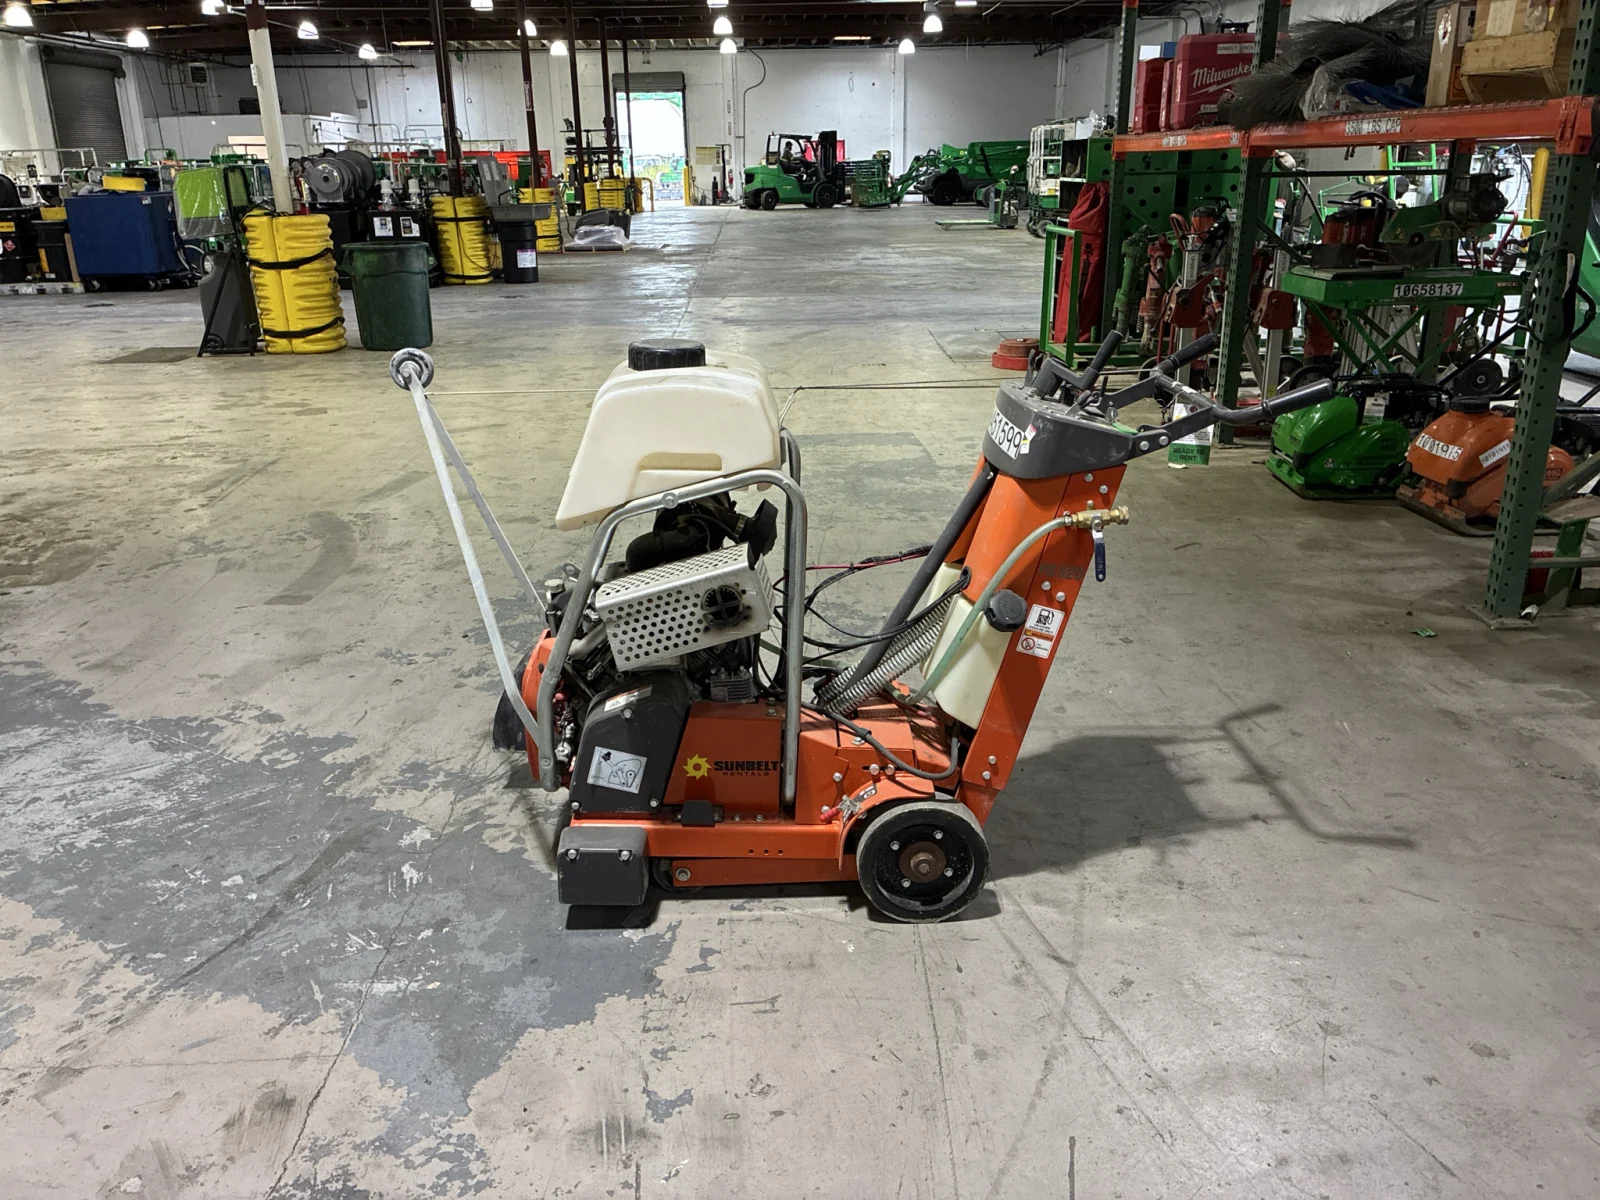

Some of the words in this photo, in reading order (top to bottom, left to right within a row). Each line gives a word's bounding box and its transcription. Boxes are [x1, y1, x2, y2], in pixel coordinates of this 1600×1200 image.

[1367, 119, 1382, 134] LBS
[1386, 118, 1401, 132] CAP
[1395, 284, 1462, 297] 10658137
[990, 411, 1022, 458] 51599
[1057, 565, 1085, 581] 520
[714, 760, 780, 771] SUNBELT
